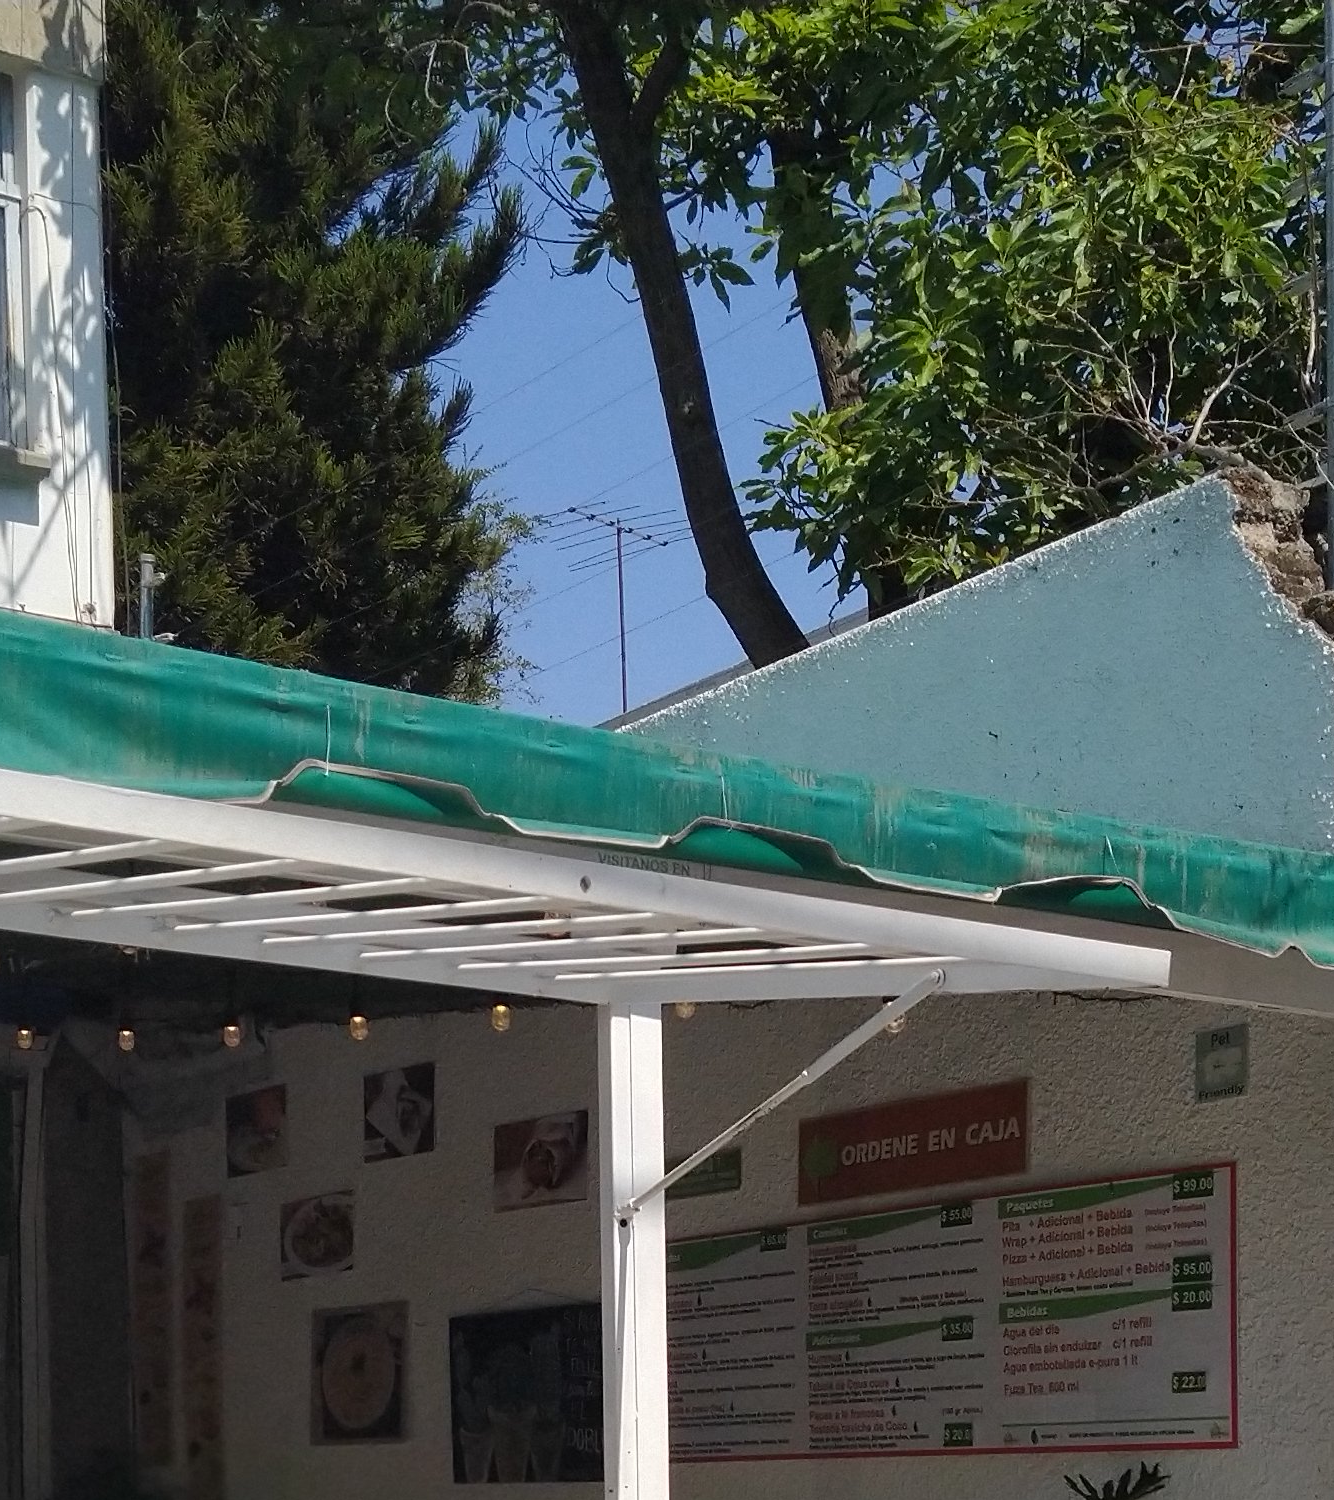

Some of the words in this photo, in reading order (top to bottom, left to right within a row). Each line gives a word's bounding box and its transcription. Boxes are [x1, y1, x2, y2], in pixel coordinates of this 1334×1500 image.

[1211, 1031, 1230, 1047] Pet
[1199, 1084, 1245, 1099] Friendly
[841, 1133, 919, 1166] ORDENE
[928, 1127, 956, 1153] EN
[966, 1116, 1021, 1145] CAJA
[1006, 1199, 1054, 1213] Paquetes
[1037, 1213, 1084, 1229] Adicional
[1096, 1208, 1133, 1221] Bebida
[1002, 1236, 1027, 1250] Wrap
[1038, 1229, 1084, 1244] Adicional
[1097, 1224, 1133, 1238] Bebida
[1002, 1253, 1027, 1265] Pizza
[1038, 1246, 1085, 1262] Adicional
[1097, 1241, 1133, 1256] Bebida
[1003, 1272, 1066, 1287] Hamburguesa
[1077, 1265, 1123, 1280] Adicional
[1135, 1262, 1170, 1275] Bebida
[1006, 1306, 1048, 1319] Bebidas
[1003, 1328, 1026, 1339] Agua
[1003, 1362, 1027, 1375] Agua
